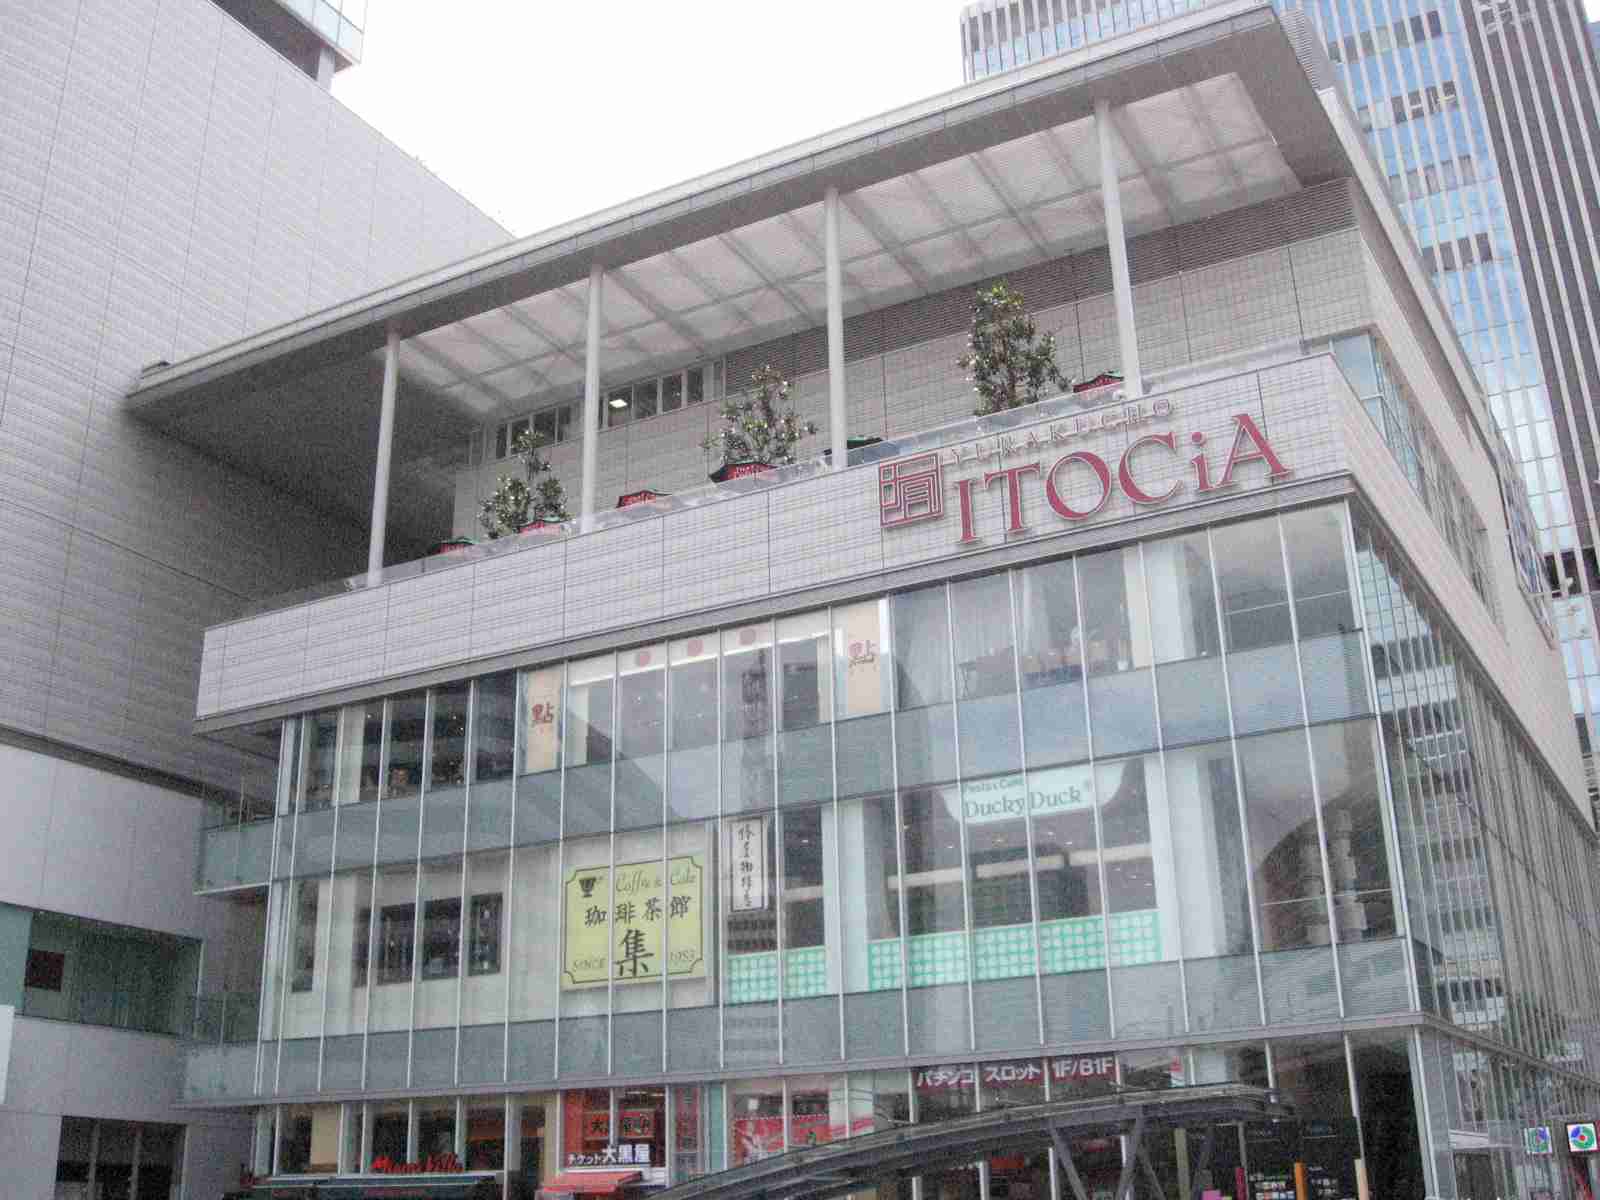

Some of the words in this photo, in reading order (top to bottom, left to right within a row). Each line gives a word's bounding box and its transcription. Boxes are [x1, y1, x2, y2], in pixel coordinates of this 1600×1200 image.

[965, 794, 1025, 818] Ducky
[1031, 786, 1082, 808] Duck
[573, 957, 606, 972] SINCE
[613, 929, 655, 977] 集
[916, 1067, 975, 1088] パチンコ
[985, 1063, 1042, 1083] スロット
[1052, 1057, 1115, 1078] 1F/B1F
